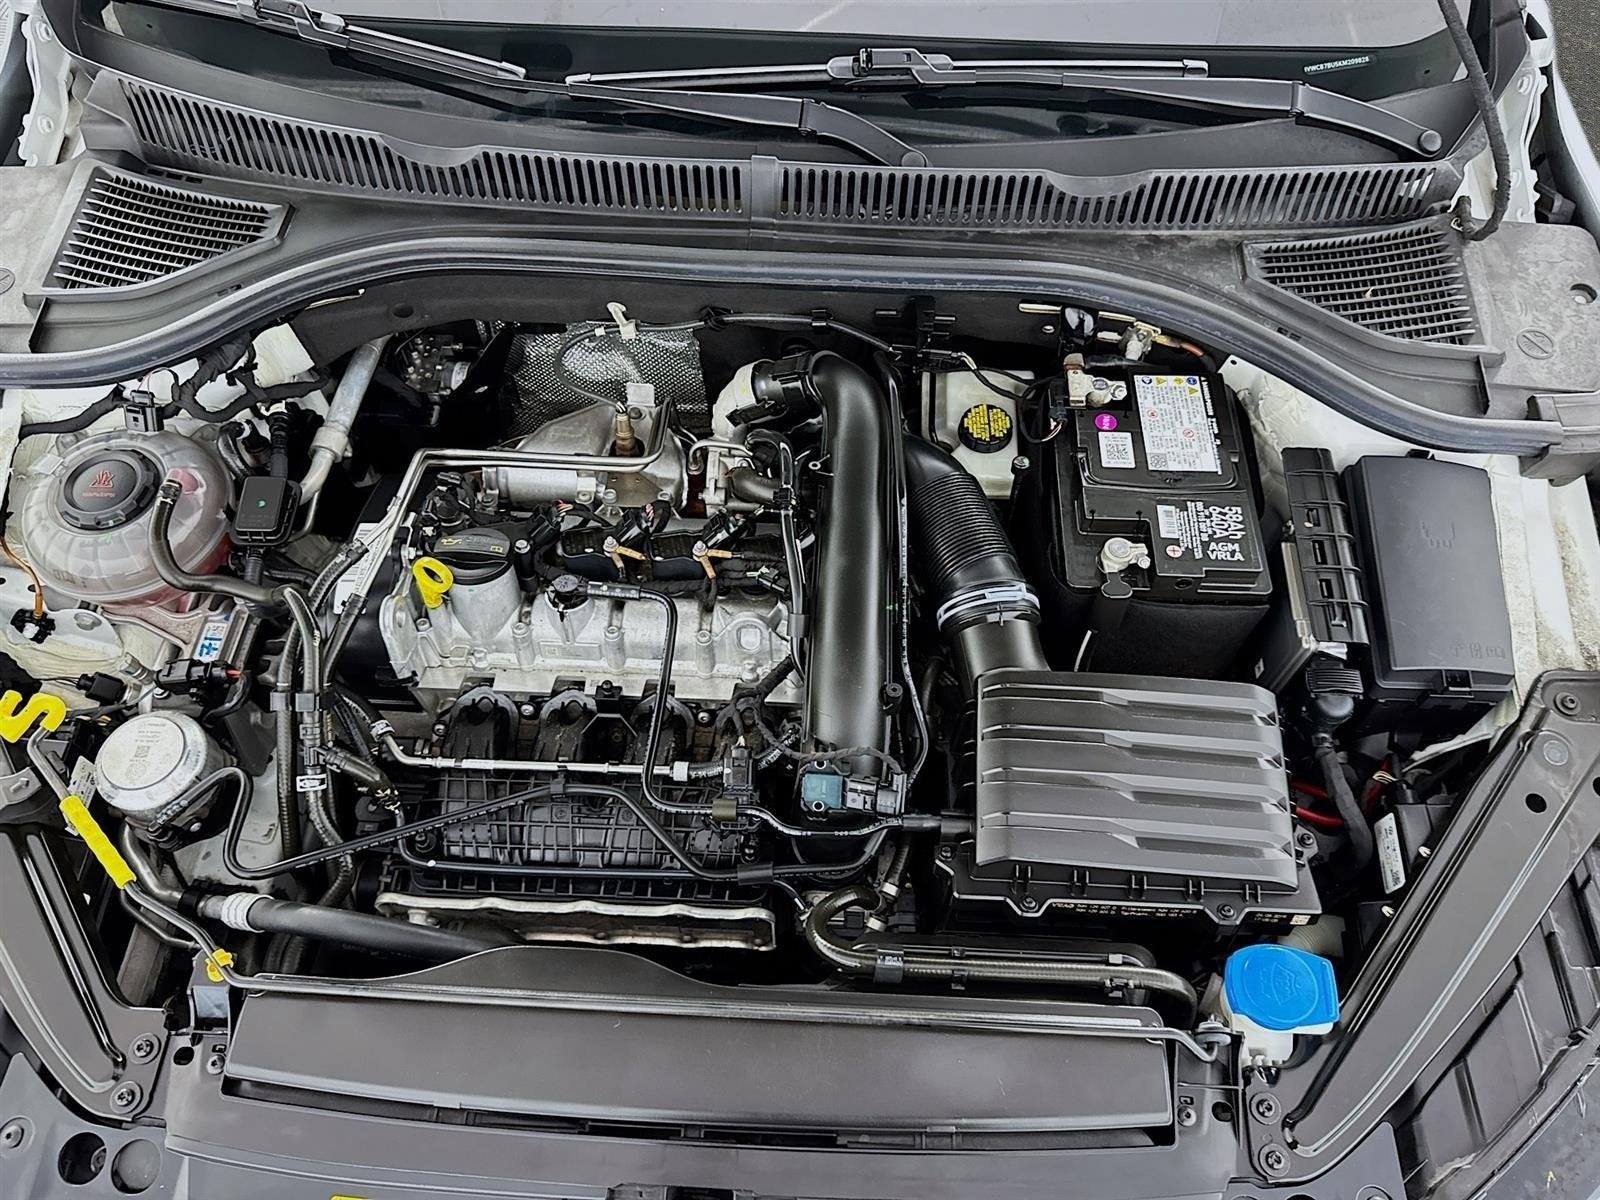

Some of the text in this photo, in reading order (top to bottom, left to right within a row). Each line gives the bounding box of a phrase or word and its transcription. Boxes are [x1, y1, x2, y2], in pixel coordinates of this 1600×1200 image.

[1208, 505, 1230, 538] 640A
[1224, 506, 1246, 539] 58Ah
[1207, 550, 1245, 562] VRLA
[1208, 541, 1240, 552] AGM
